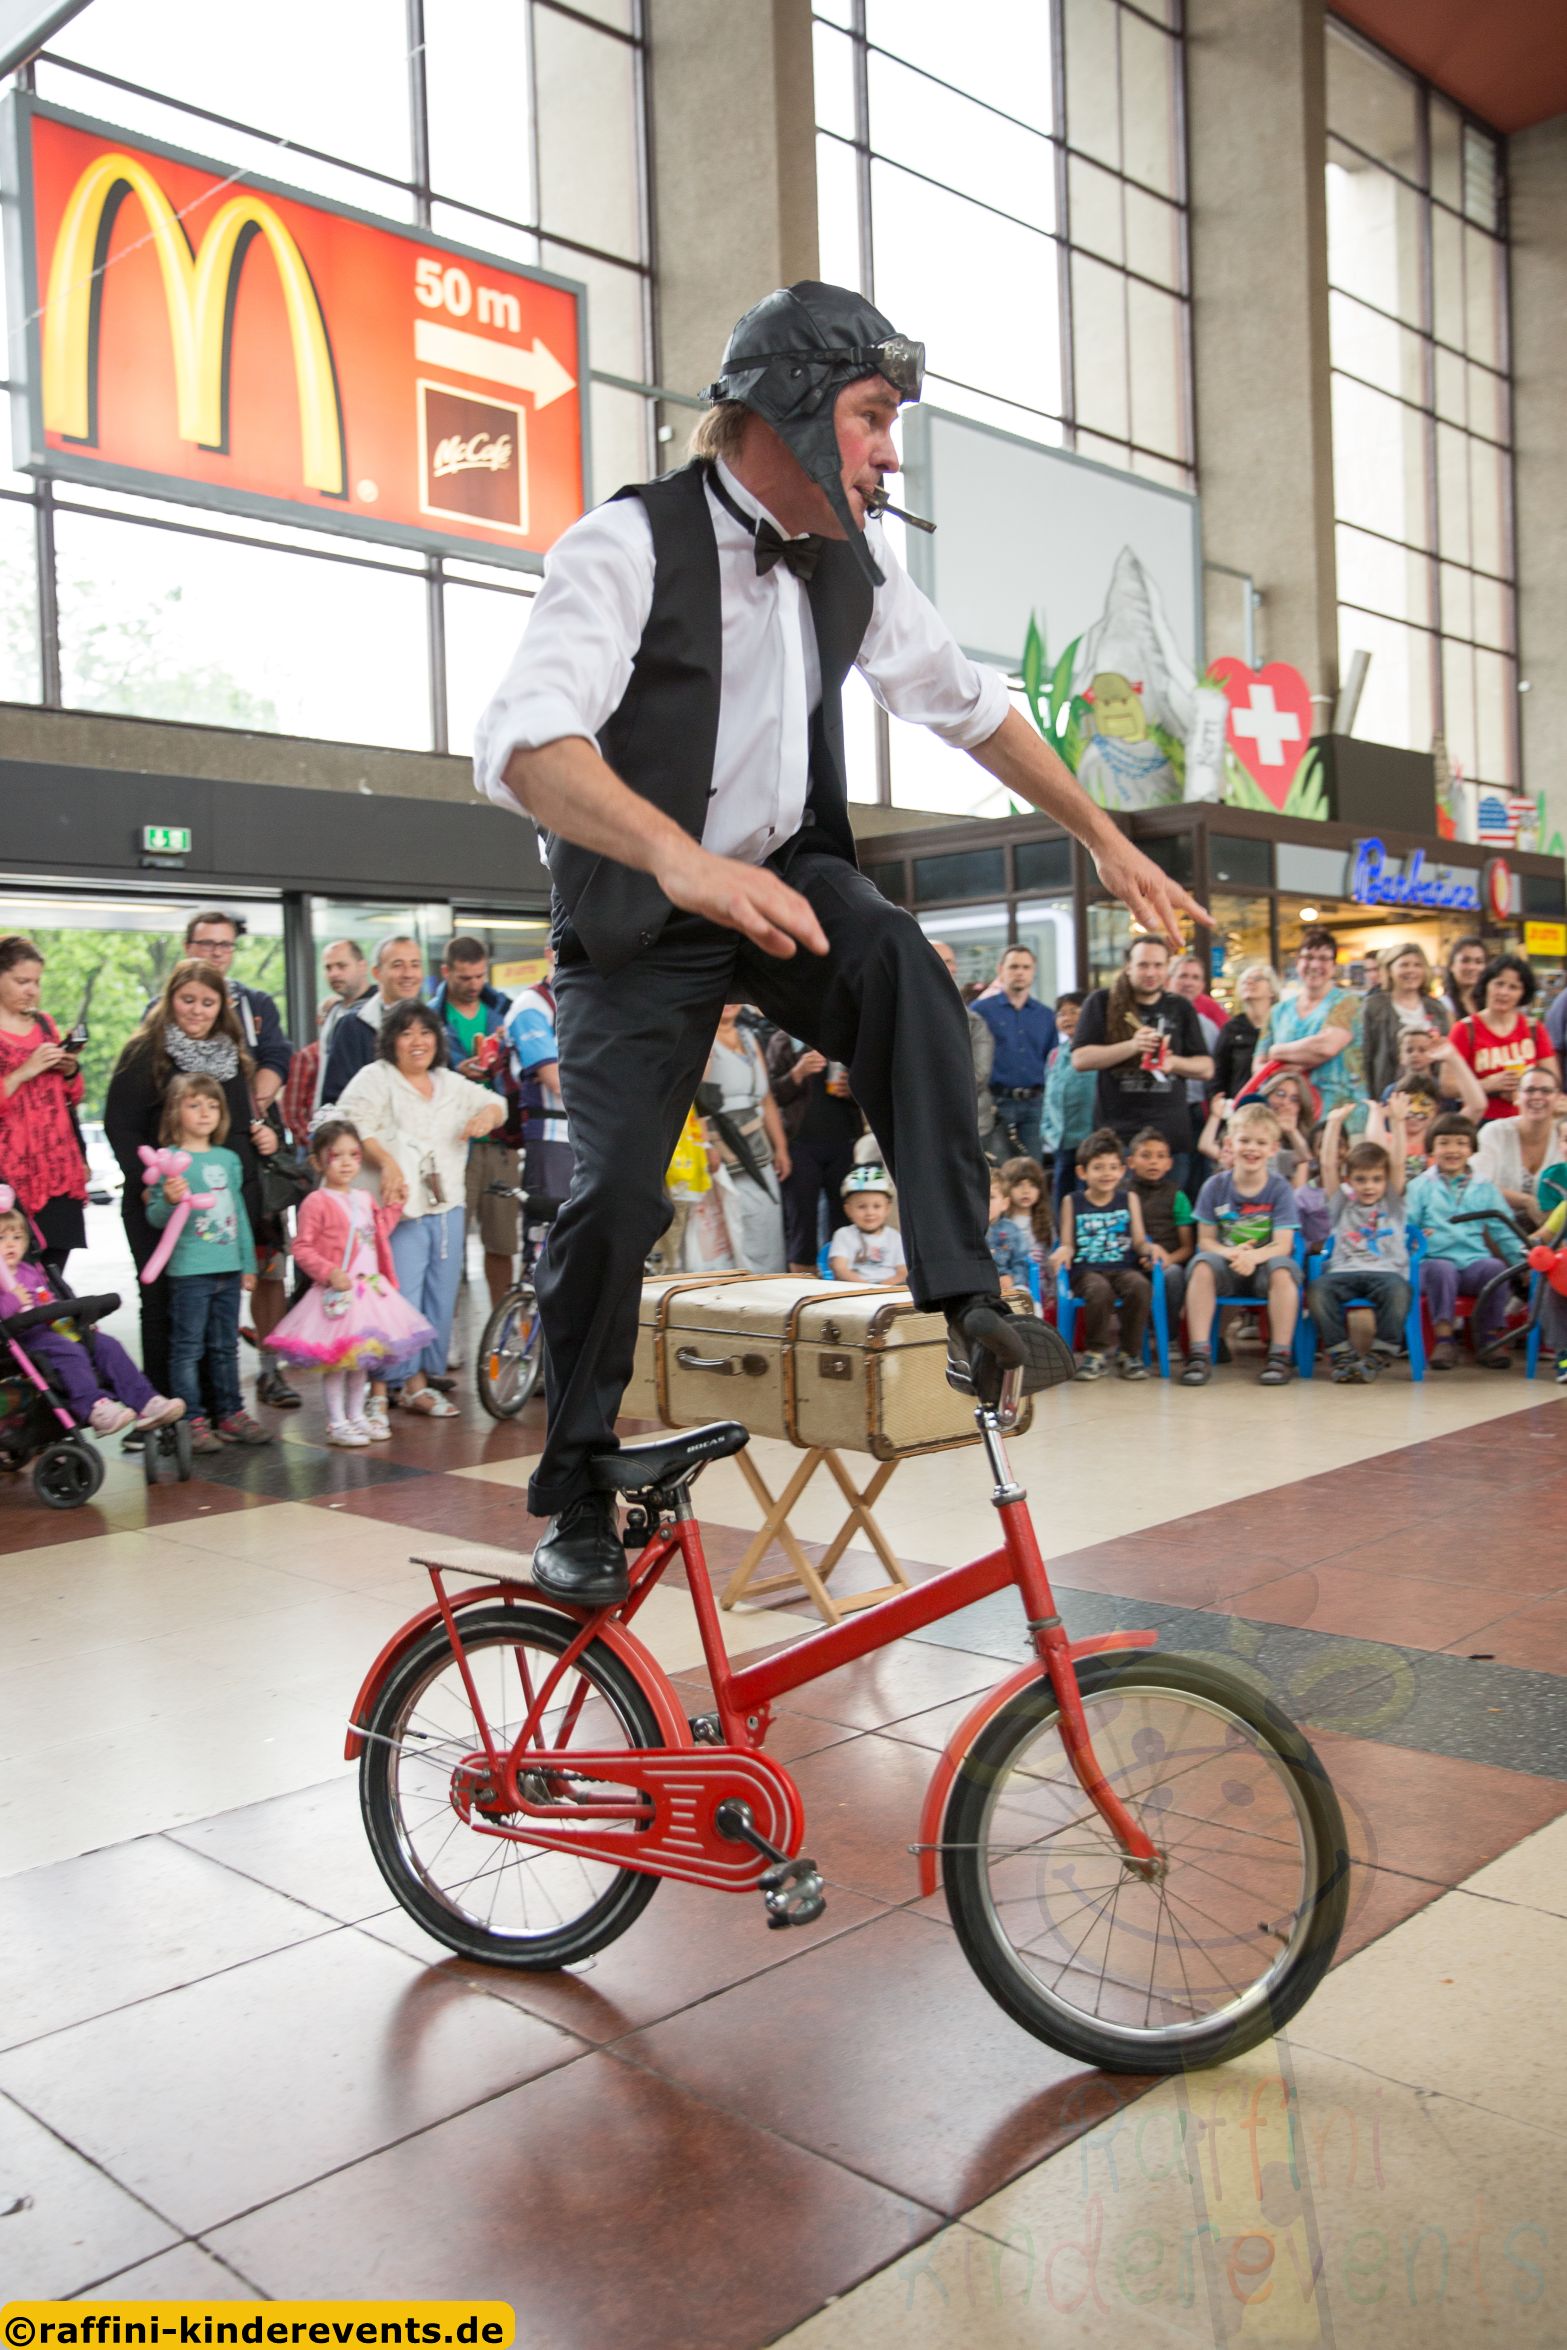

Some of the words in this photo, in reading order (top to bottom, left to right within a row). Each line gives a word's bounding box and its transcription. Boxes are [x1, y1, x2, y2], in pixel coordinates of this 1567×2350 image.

[414, 257, 472, 317] 50
[477, 286, 521, 333] m
[1475, 1037, 1536, 1073] HALLO
